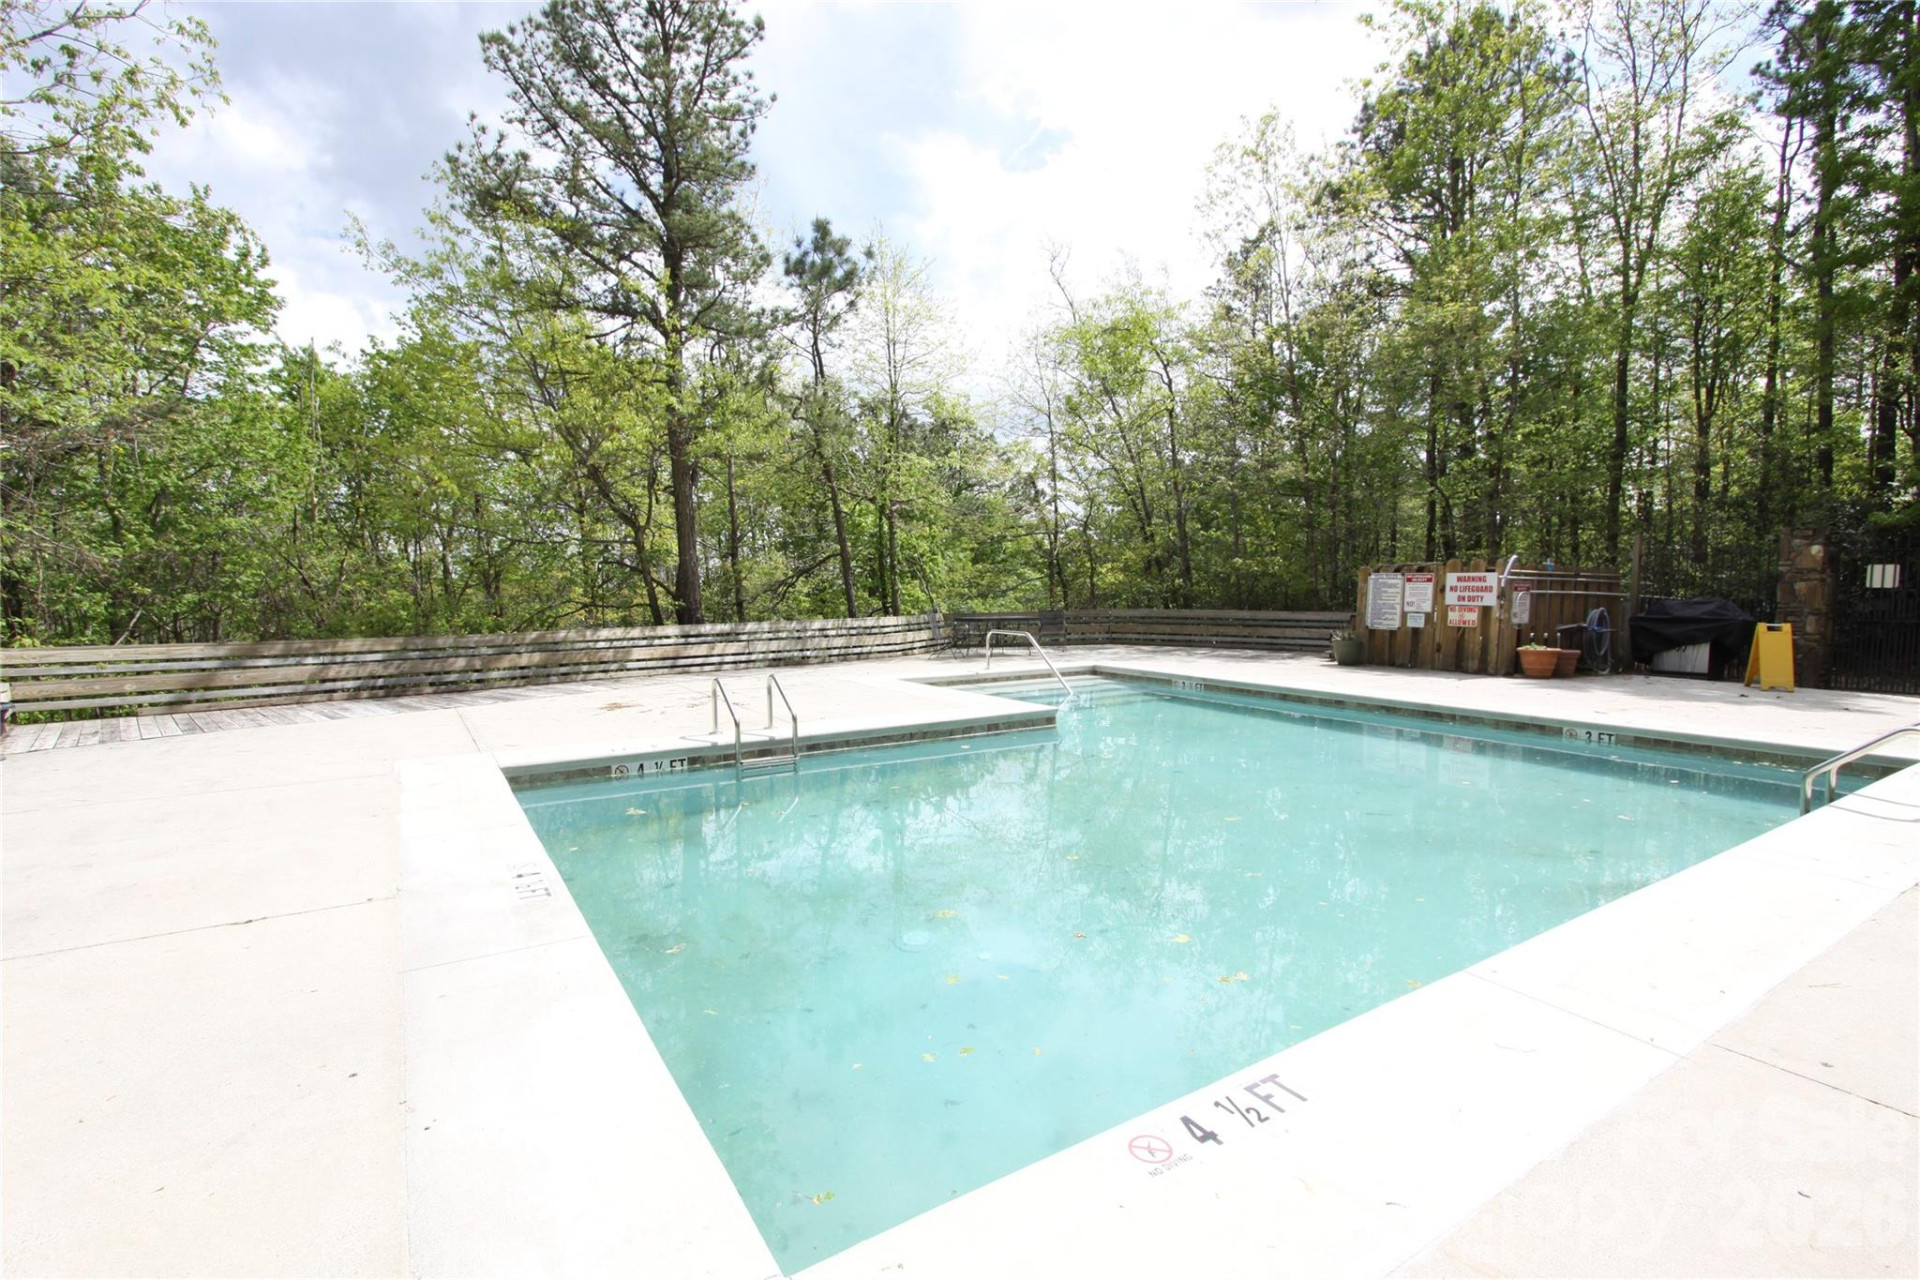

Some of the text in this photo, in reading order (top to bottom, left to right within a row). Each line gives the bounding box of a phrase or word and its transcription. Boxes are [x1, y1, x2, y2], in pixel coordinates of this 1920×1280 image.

[1456, 575, 1487, 583] WARNING
[1449, 585, 1494, 593] NO LIFEGUARD
[1598, 732, 1615, 742] FT
[669, 758, 687, 769] FT
[1180, 1115, 1224, 1146] 4
[1243, 1073, 1308, 1113] FT
[1148, 1153, 1194, 1178] NO DIVING
